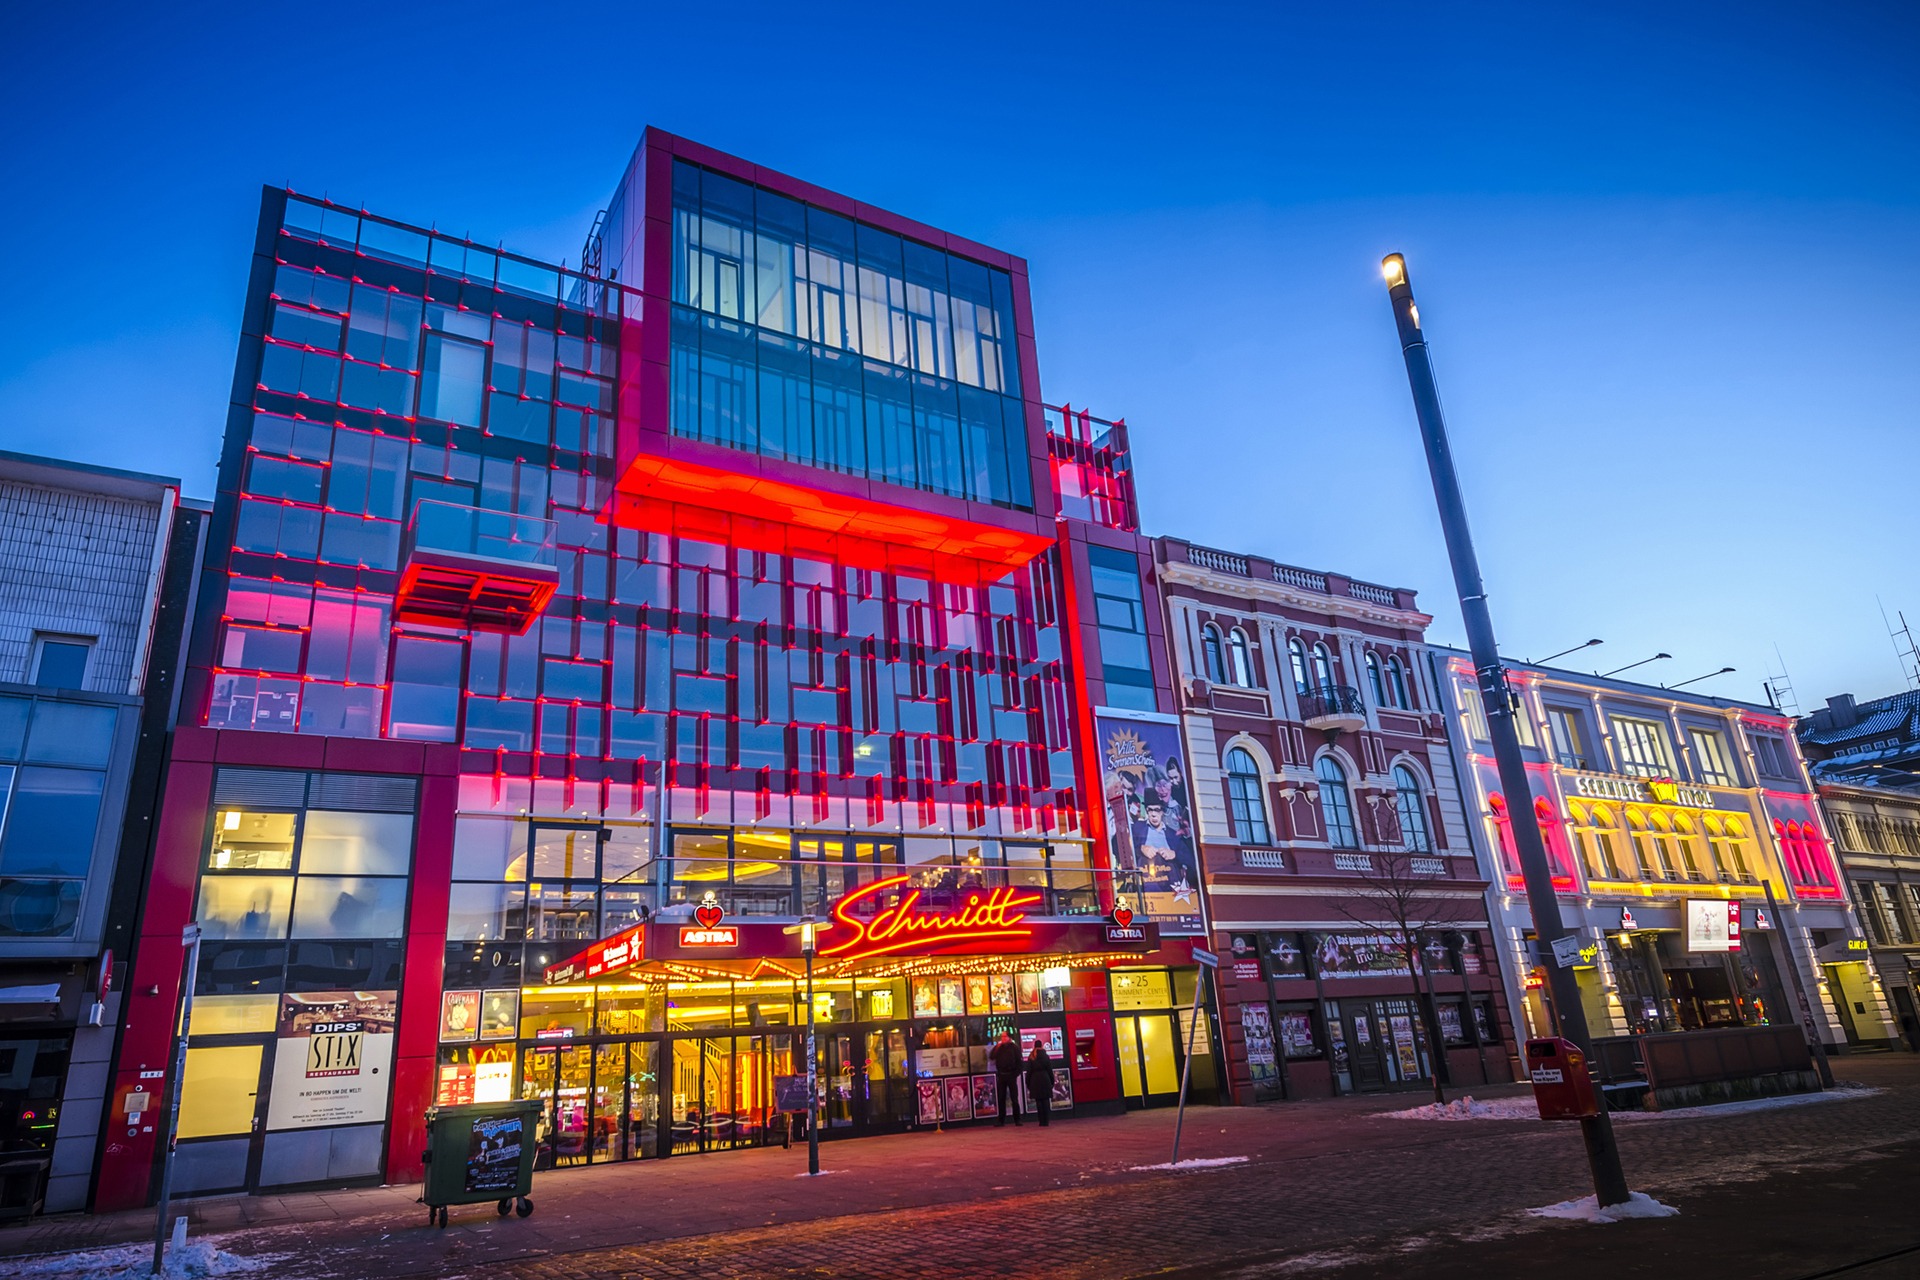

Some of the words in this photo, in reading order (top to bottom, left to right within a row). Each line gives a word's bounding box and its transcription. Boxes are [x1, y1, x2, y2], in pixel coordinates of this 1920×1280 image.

[1115, 740, 1136, 755] Villa
[1107, 752, 1156, 770] Sonnenschein
[1575, 777, 1645, 801] SCHMIDTS
[818, 874, 1041, 955] Schmidt
[683, 931, 735, 943] ASTRA
[1110, 929, 1143, 938] ASTRA
[447, 993, 476, 1006] CAVEMAN
